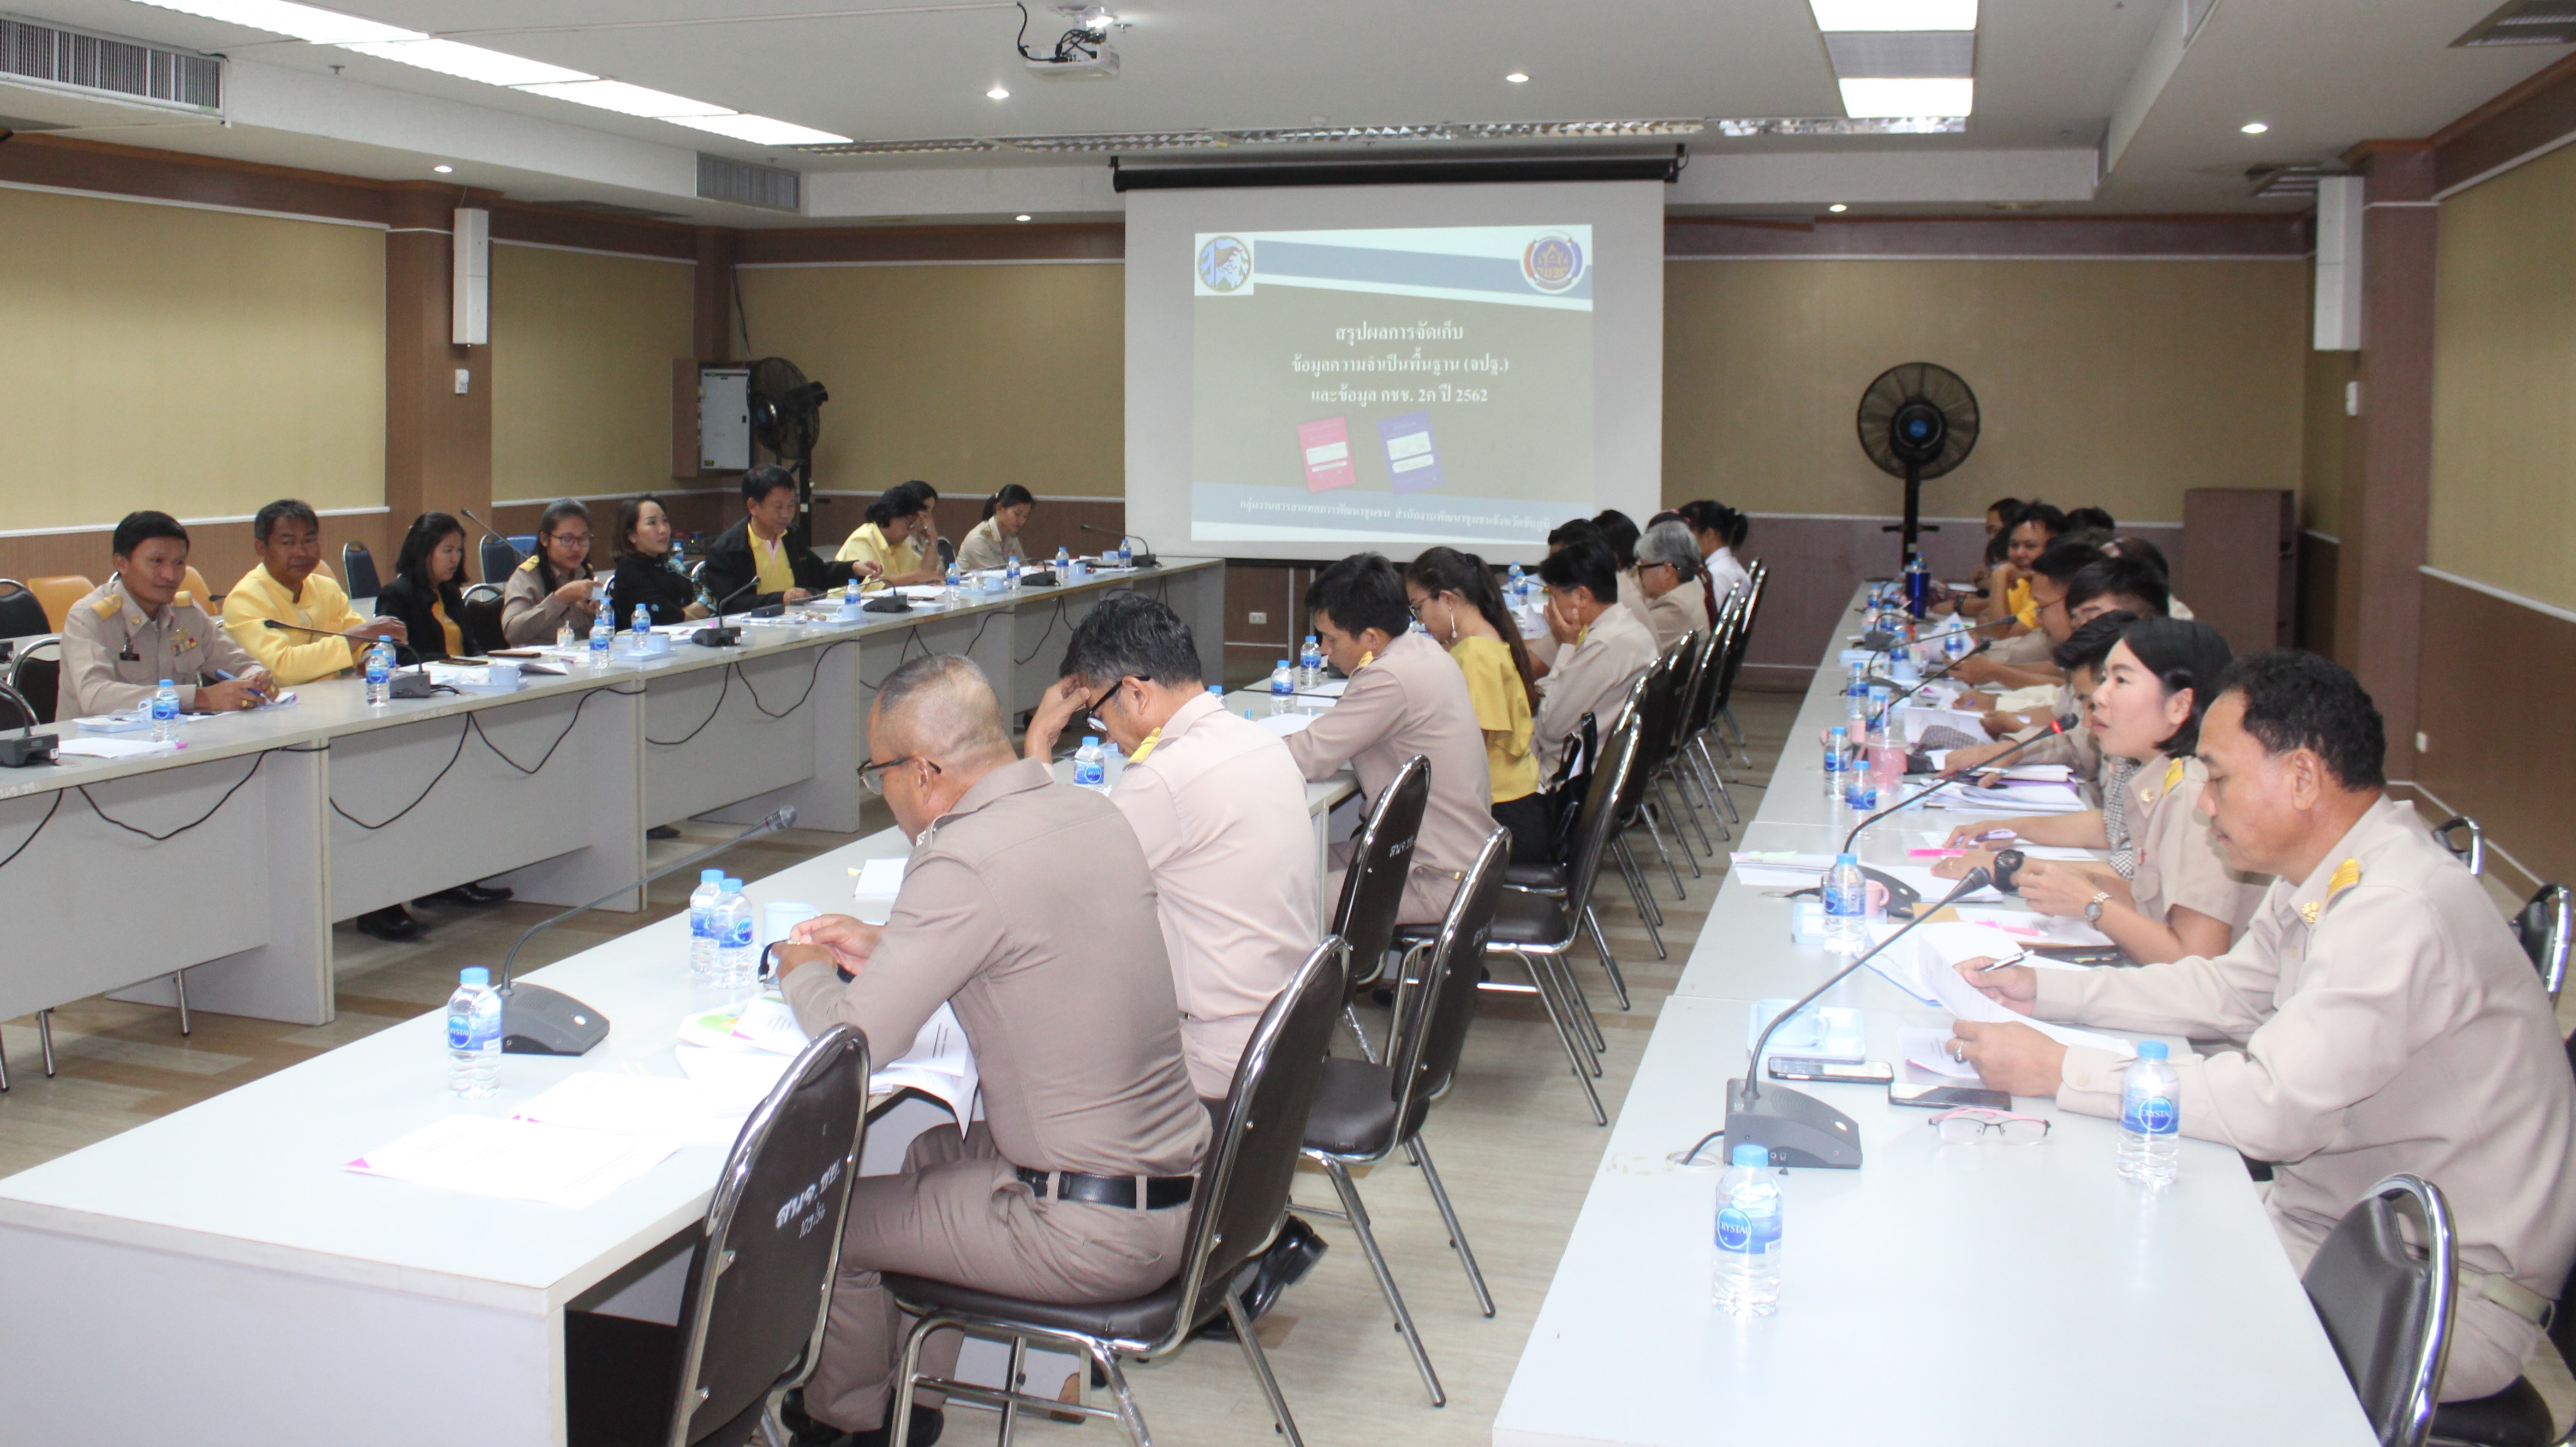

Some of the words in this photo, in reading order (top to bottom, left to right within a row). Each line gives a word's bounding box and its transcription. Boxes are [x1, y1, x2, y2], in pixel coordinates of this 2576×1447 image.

[1335, 320, 1464, 346] สรุปผลการจัดเก็บ
[1291, 347, 1459, 377] ข้อมูลความจำเป็นพื้นฐาน
[1464, 352, 1510, 375] (จปฐ.)
[1311, 383, 1376, 407] และข้อมูล
[1381, 389, 1414, 402] กชช.
[1438, 384, 1452, 402] ปี
[1456, 389, 1488, 402] 2562
